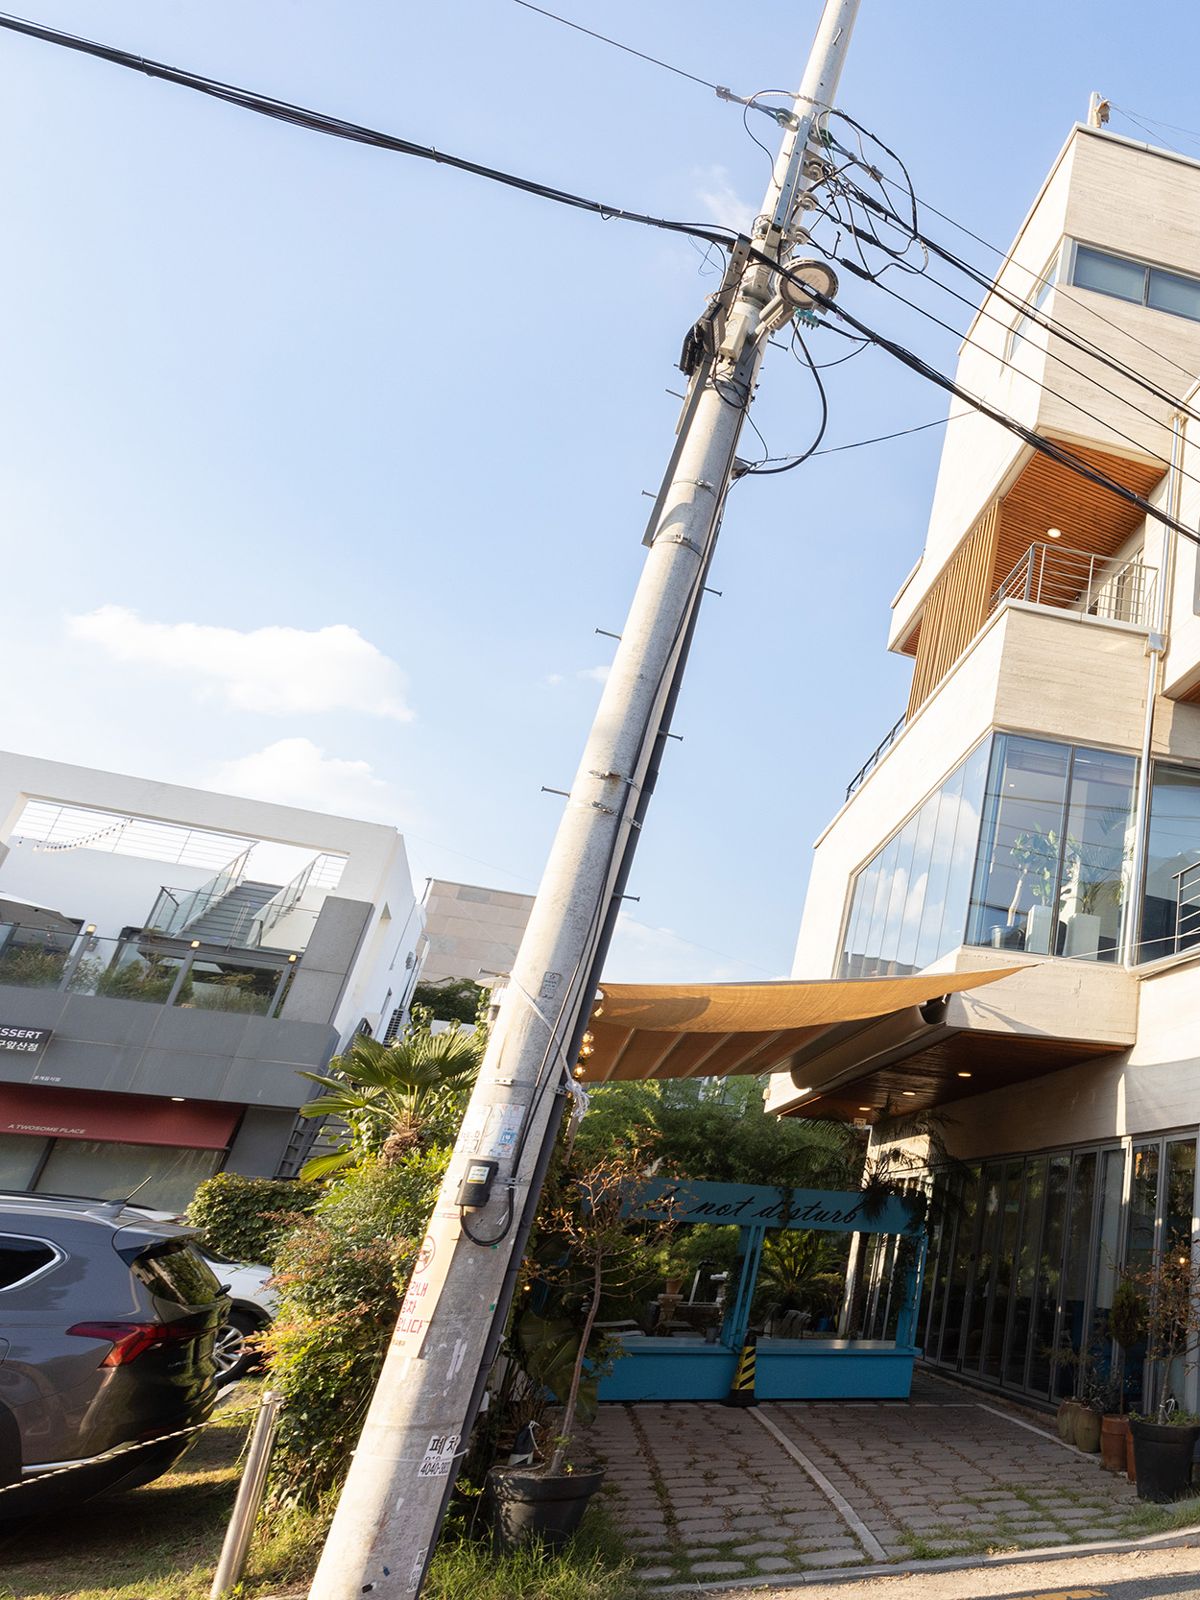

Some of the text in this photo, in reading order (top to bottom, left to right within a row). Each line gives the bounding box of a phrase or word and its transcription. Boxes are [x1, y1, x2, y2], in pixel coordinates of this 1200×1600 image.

[0, 1027, 43, 1039] SSERT
[16, 1124, 58, 1132] TWOSOME
[686, 1196, 755, 1217] not
